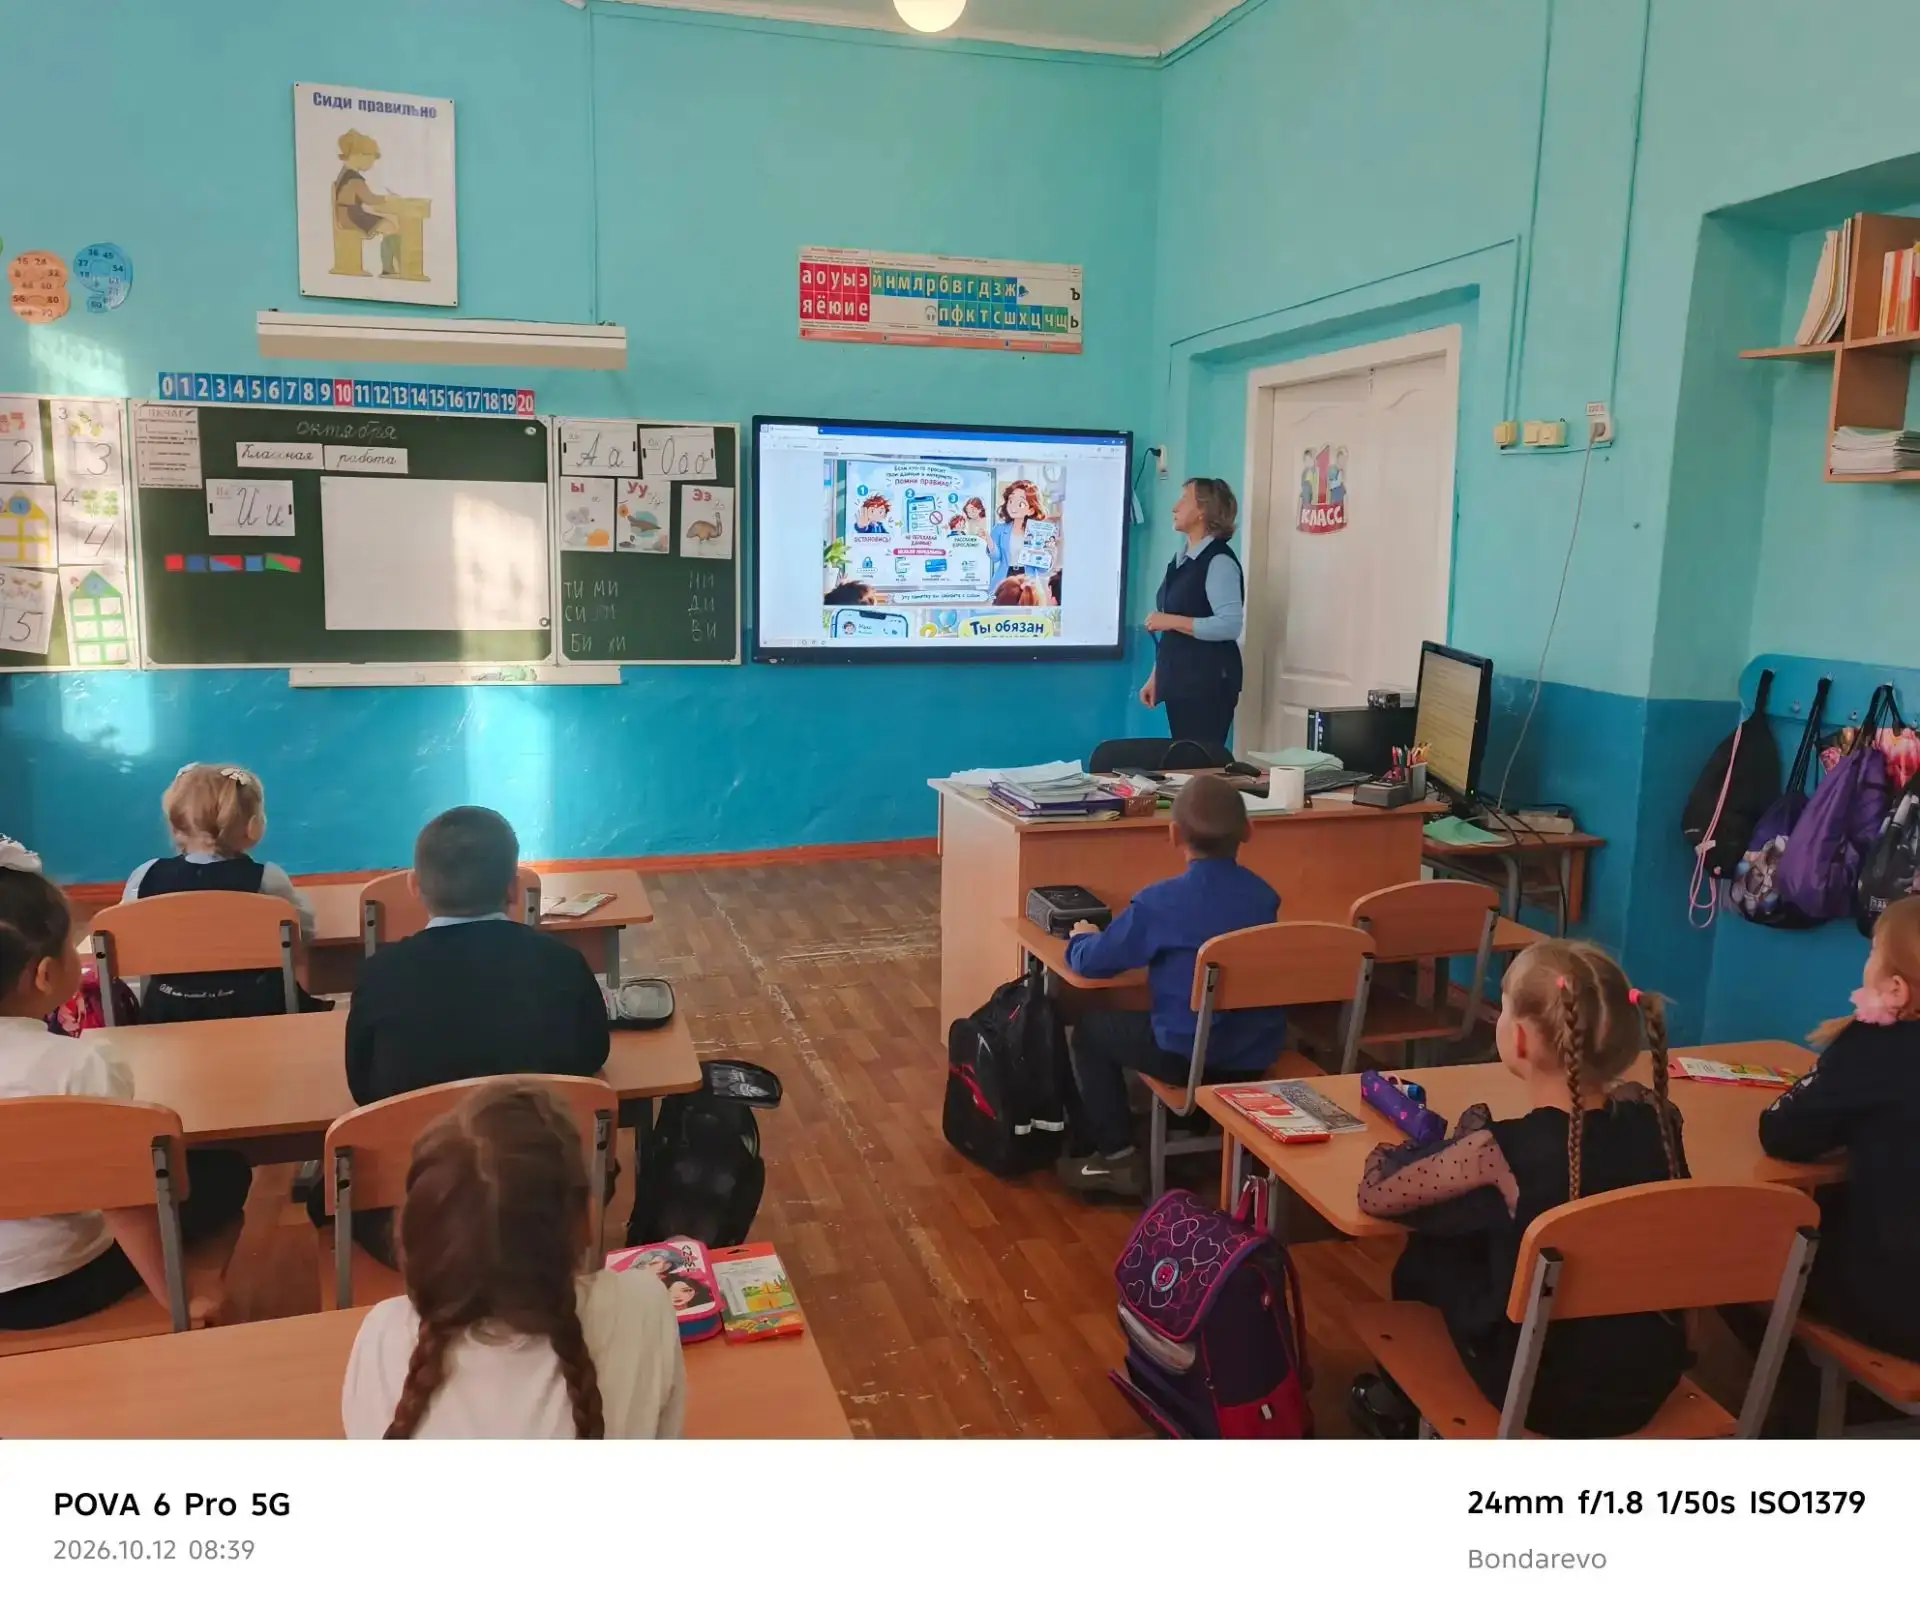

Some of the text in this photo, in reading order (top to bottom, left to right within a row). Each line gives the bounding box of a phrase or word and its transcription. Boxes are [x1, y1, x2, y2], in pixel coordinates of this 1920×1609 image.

[312, 92, 437, 119] Сиди правильно
[162, 376, 533, 412] 0 1 2 3 4 5 6 7 8 9 10 11 12 13 14 15 16 17 18 19 20
[59, 407, 69, 421] 3
[296, 421, 397, 444] октября
[11, 439, 35, 475] 2
[87, 443, 112, 476] 3
[336, 449, 397, 468] работа
[576, 431, 624, 468] А а
[661, 437, 675, 475] О
[1316, 444, 1330, 504] 1
[62, 488, 80, 506] 4
[627, 481, 649, 498] Уу
[692, 488, 712, 502] Ээ
[237, 487, 285, 527] И и
[1301, 505, 1343, 527] КЛАСС
[84, 523, 115, 557] 4
[9, 611, 43, 642] 5
[970, 619, 1045, 635] Ты обязан
